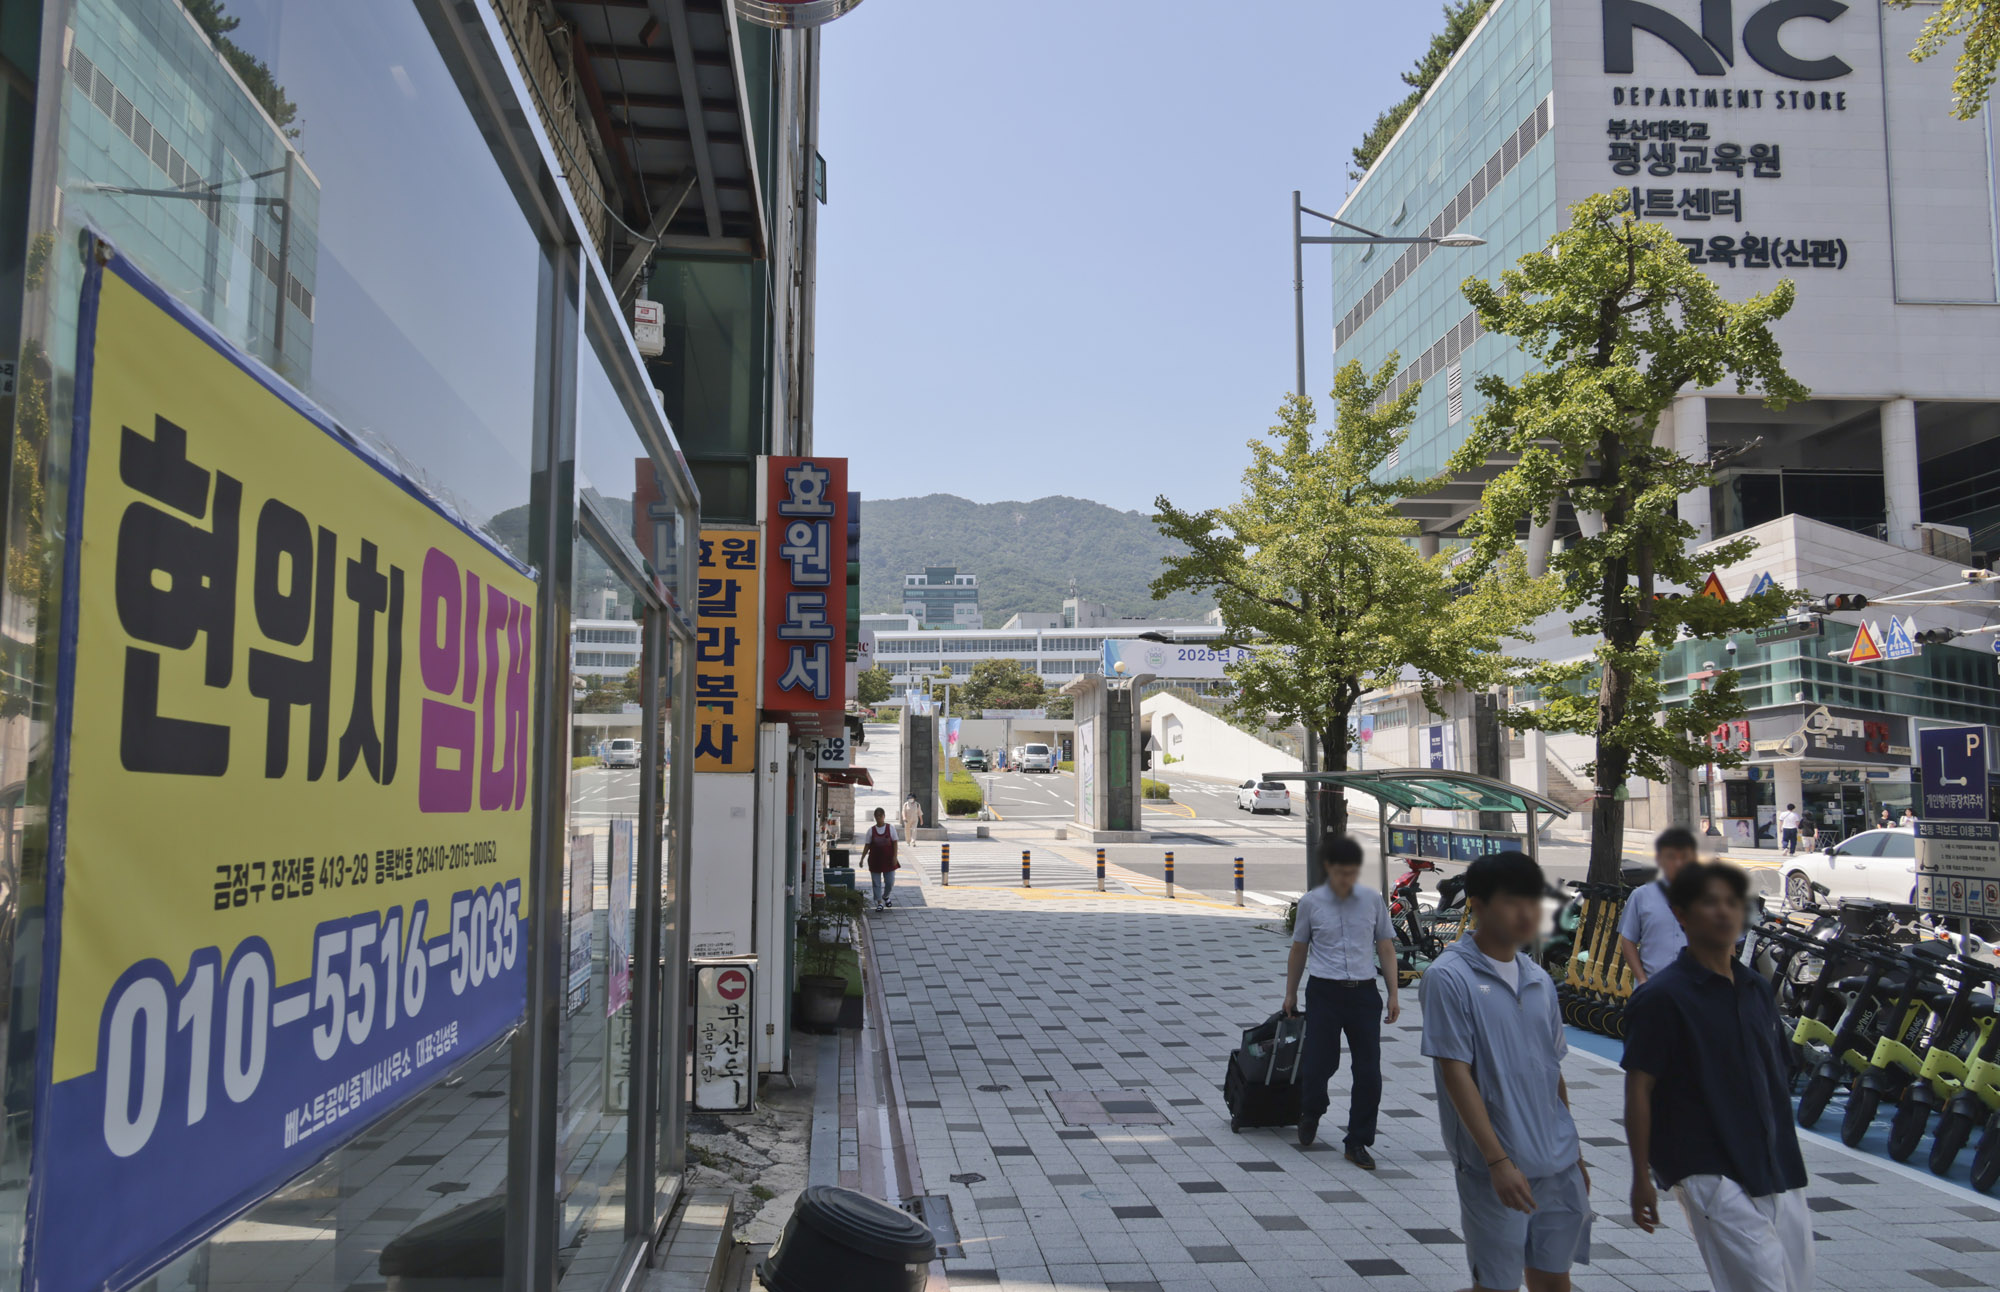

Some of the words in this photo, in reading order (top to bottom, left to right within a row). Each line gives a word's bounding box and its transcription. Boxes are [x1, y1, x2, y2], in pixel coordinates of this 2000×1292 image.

[1603, 0, 1853, 81] NC
[1613, 86, 1763, 109] DEPARTMENT
[1776, 90, 1847, 111] STORE
[1607, 119, 1710, 141] 부산대학교
[1608, 142, 1781, 178] 평생교육원
[1646, 232, 1848, 270] 교육원(신관)
[697, 538, 757, 570] 효원
[778, 461, 835, 699] 효원도서
[115, 413, 405, 786] 현위치
[419, 546, 531, 813] 임대
[694, 578, 742, 765] 칼라복사
[1178, 648, 1230, 663] 2025년
[1966, 733, 1980, 757] P
[1926, 794, 1984, 809] 개인형이동장치주차
[1919, 824, 1934, 836] 전동
[1936, 824, 1958, 837] 킥보드
[1960, 825, 1992, 838] 이용규칙
[214, 861, 266, 911] 금정구
[271, 857, 315, 901] 장전동
[319, 853, 369, 889] 413-29
[375, 847, 413, 885] 등록번호
[416, 840, 497, 875] 26410-2015-00052
[103, 884, 520, 1158] 010-5516-5035
[1905, 1016, 1924, 1042] SWING
[701, 1023, 716, 1083] 골목안
[1948, 1028, 1970, 1054] SWING
[284, 1048, 412, 1149] 베스트공인중개사사무소
[416, 1020, 458, 1069] 대표:김성욱
